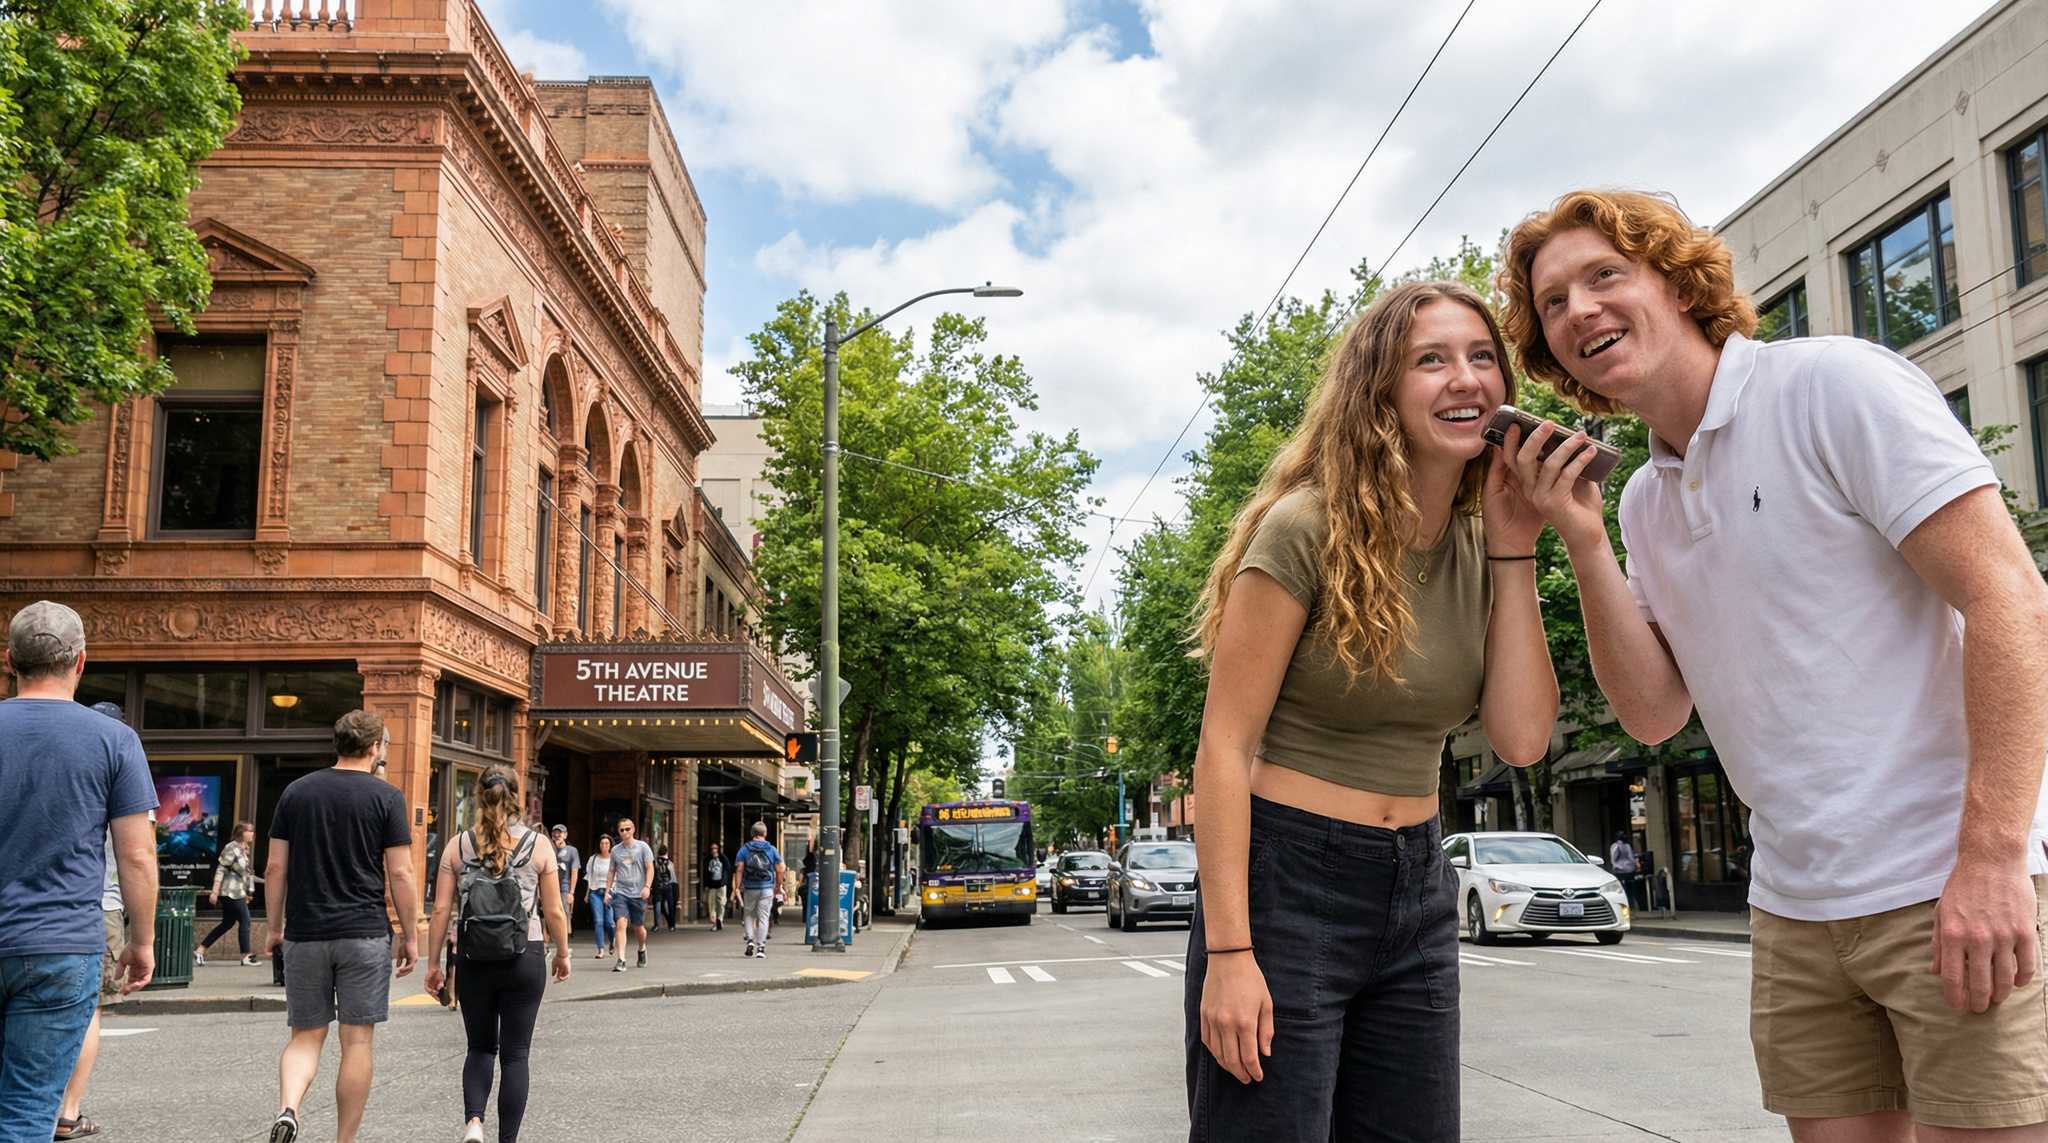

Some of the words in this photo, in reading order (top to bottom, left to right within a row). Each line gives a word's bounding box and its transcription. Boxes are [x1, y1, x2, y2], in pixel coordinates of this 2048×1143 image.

[576, 659, 619, 680] 5TH
[624, 662, 708, 679] AVENUE
[594, 684, 689, 702] THEATRE
